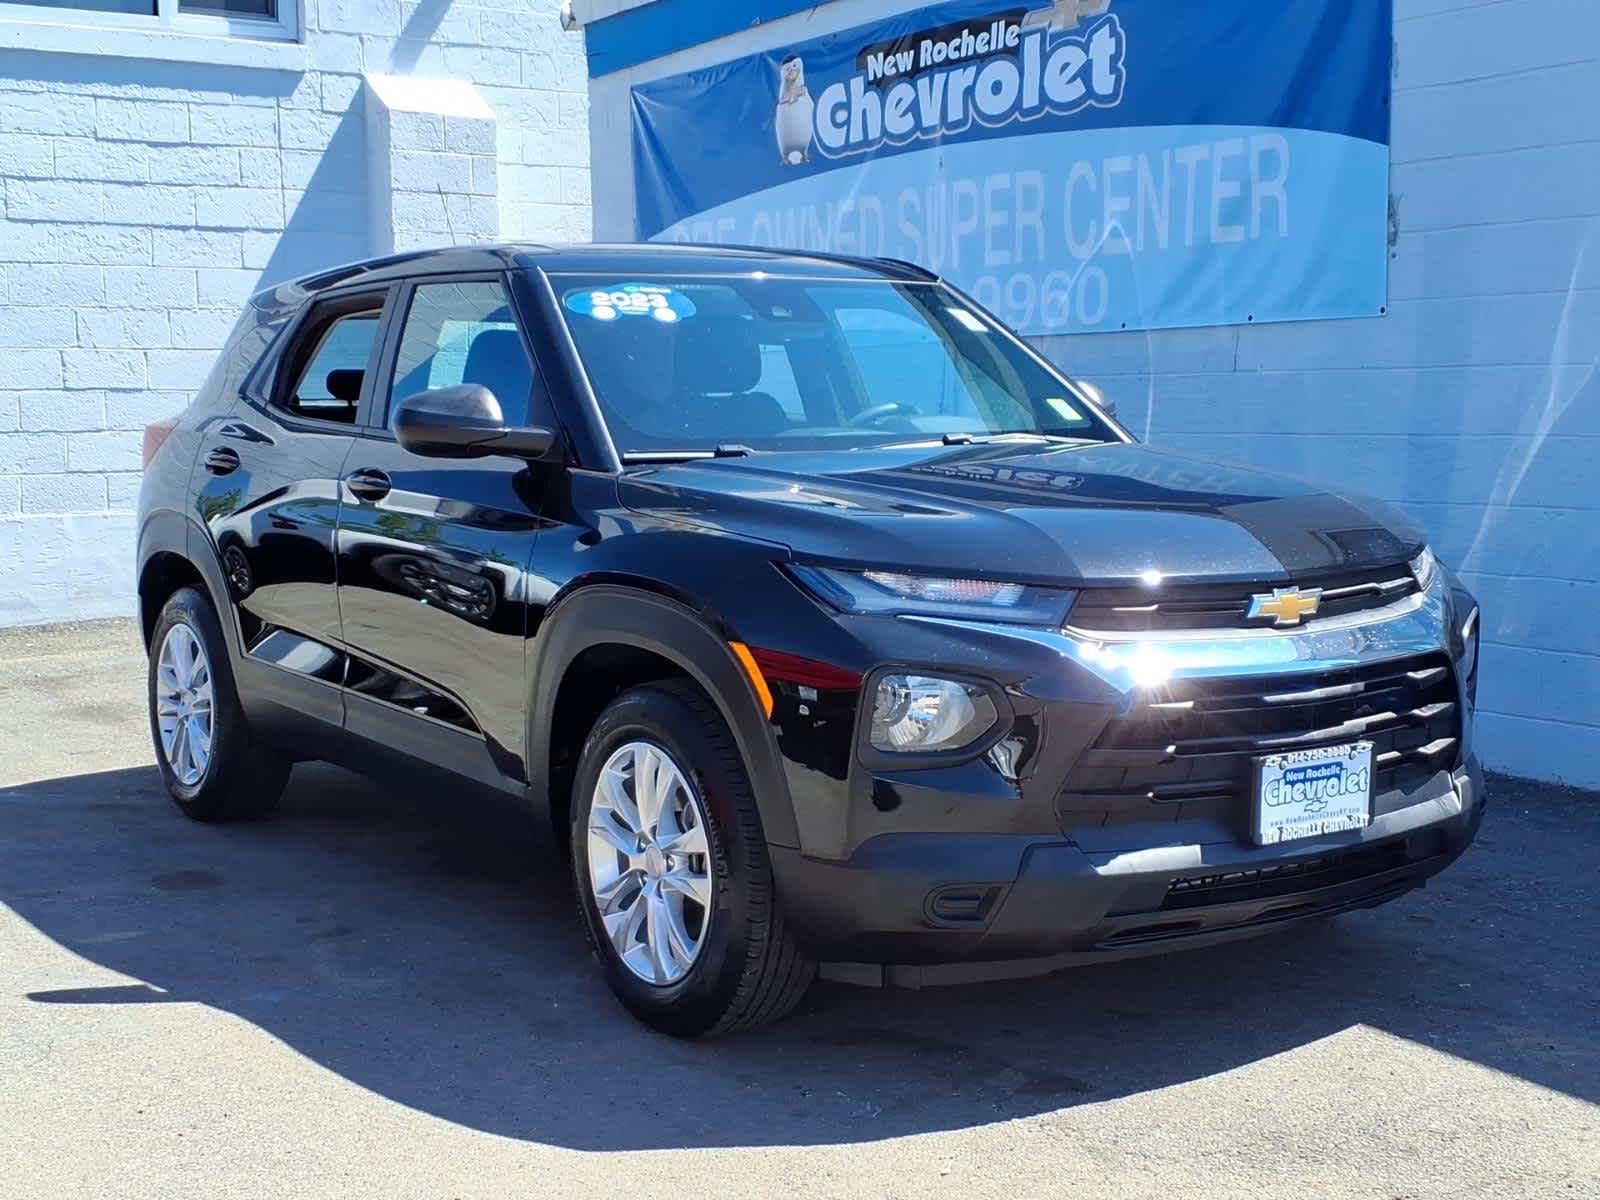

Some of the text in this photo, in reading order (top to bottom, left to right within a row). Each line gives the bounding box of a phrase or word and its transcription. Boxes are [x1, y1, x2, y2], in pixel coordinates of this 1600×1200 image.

[867, 20, 1021, 80] New Rochelle
[815, 21, 1118, 150] Chevrolet
[898, 169, 1047, 270] SUPER
[1063, 132, 1290, 260] CENTER
[1265, 767, 1369, 807] Chevrolet
[1286, 764, 1341, 781] New Rochelle
[1281, 820, 1322, 841] ROCHELLE
[1322, 813, 1370, 834] CHEVROLET
